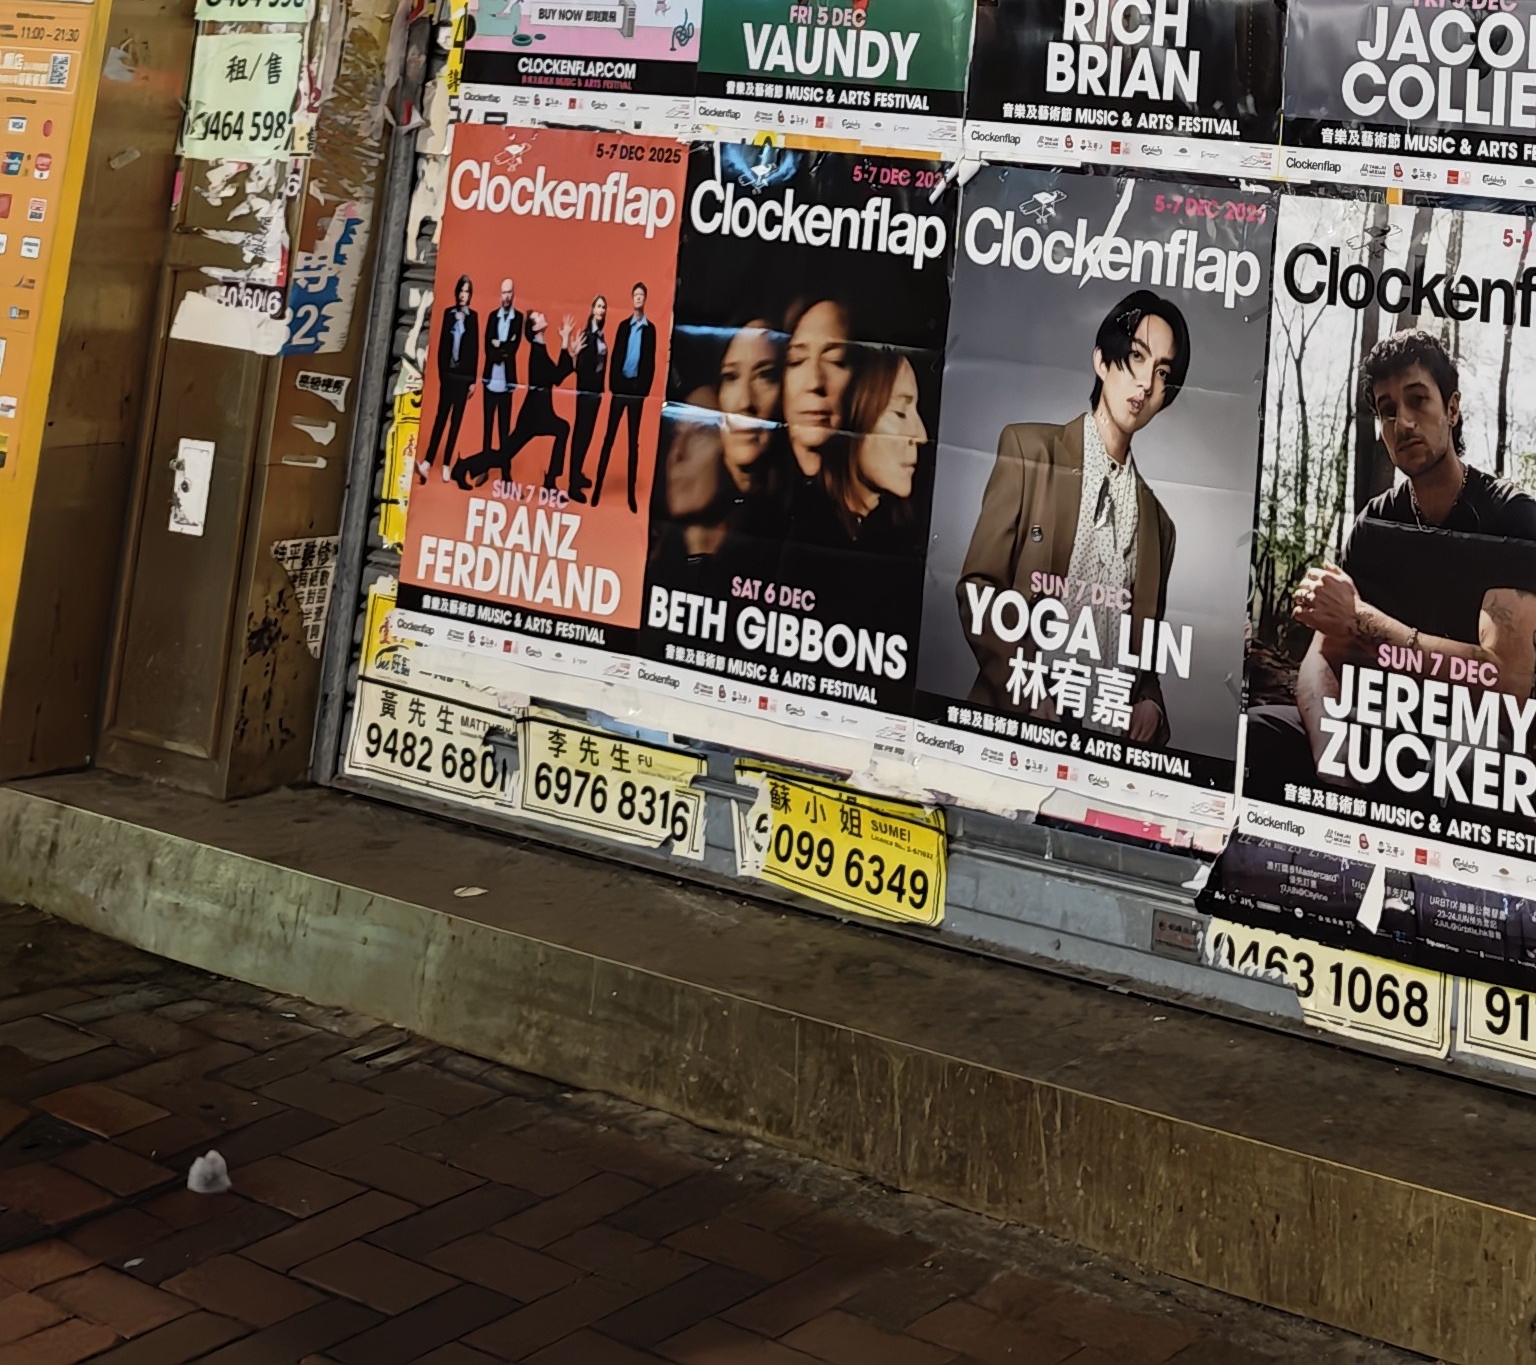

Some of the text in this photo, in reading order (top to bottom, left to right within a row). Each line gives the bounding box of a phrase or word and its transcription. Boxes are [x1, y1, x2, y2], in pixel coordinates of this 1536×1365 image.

[517, 56, 635, 79] CLOCKENFLAP.COM
[743, 22, 920, 81] VAUNDY
[1046, 40, 1200, 102] BRIAN
[726, 79, 929, 111] 音樂及藝術節 MUSIC & ARTS FESTIVAL
[451, 159, 676, 239] Clockenflap
[465, 498, 581, 561] FRANZ
[418, 537, 621, 617] FERDINAND
[649, 587, 909, 679] BETH GIBBONS
[965, 581, 1194, 680] YOGA LIN
[1008, 648, 1134, 730] 林宥嘉
[534, 763, 606, 812] 6976
[637, 754, 653, 767] FU
[871, 820, 911, 840] SUMEI
[843, 849, 929, 909] 6349
